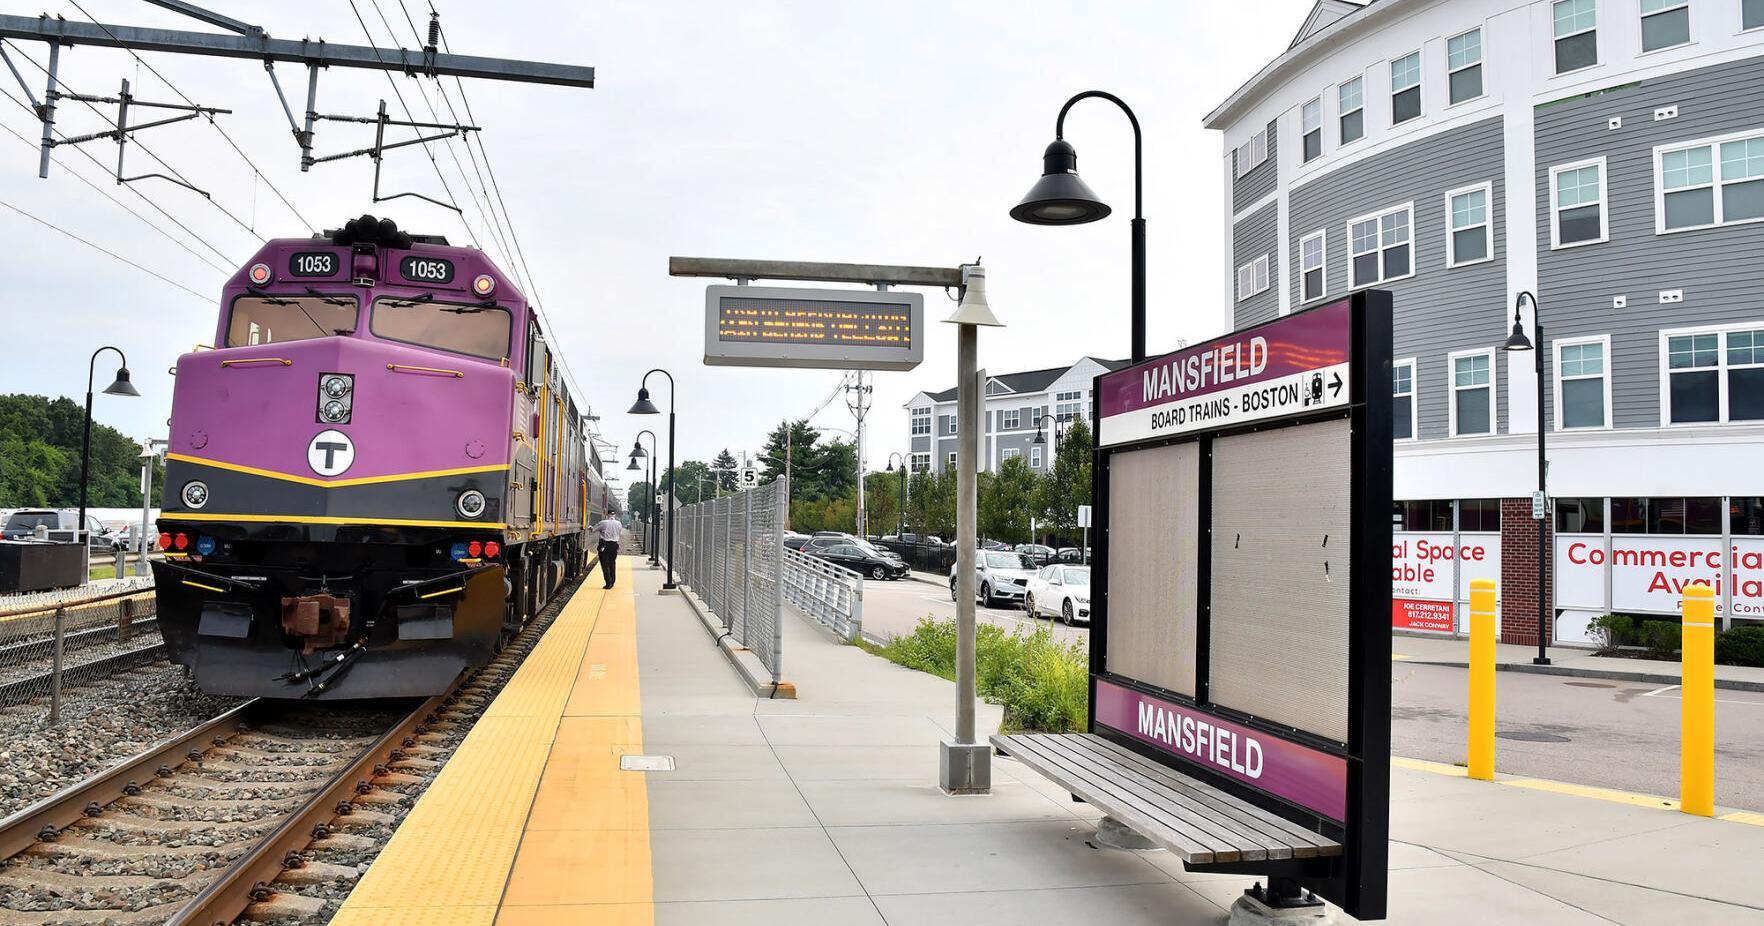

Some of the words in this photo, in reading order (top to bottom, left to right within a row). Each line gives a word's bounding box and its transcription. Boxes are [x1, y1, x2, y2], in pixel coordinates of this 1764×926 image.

[298, 255, 331, 273] 1053
[409, 260, 446, 279] 1053
[1143, 336, 1268, 402] MANSFIELD
[1151, 407, 1186, 430] BOARD
[1189, 397, 1230, 421] TRAINS
[1242, 383, 1298, 413] BOSTON
[315, 442, 347, 469] T
[744, 471, 755, 482] 5
[1416, 540, 1485, 564] Space
[1568, 543, 1763, 569] Commercia
[1407, 611, 1450, 620] 617.212.9341
[1415, 604, 1450, 612] CERRETANI
[1138, 701, 1263, 779] MANSFIELD
